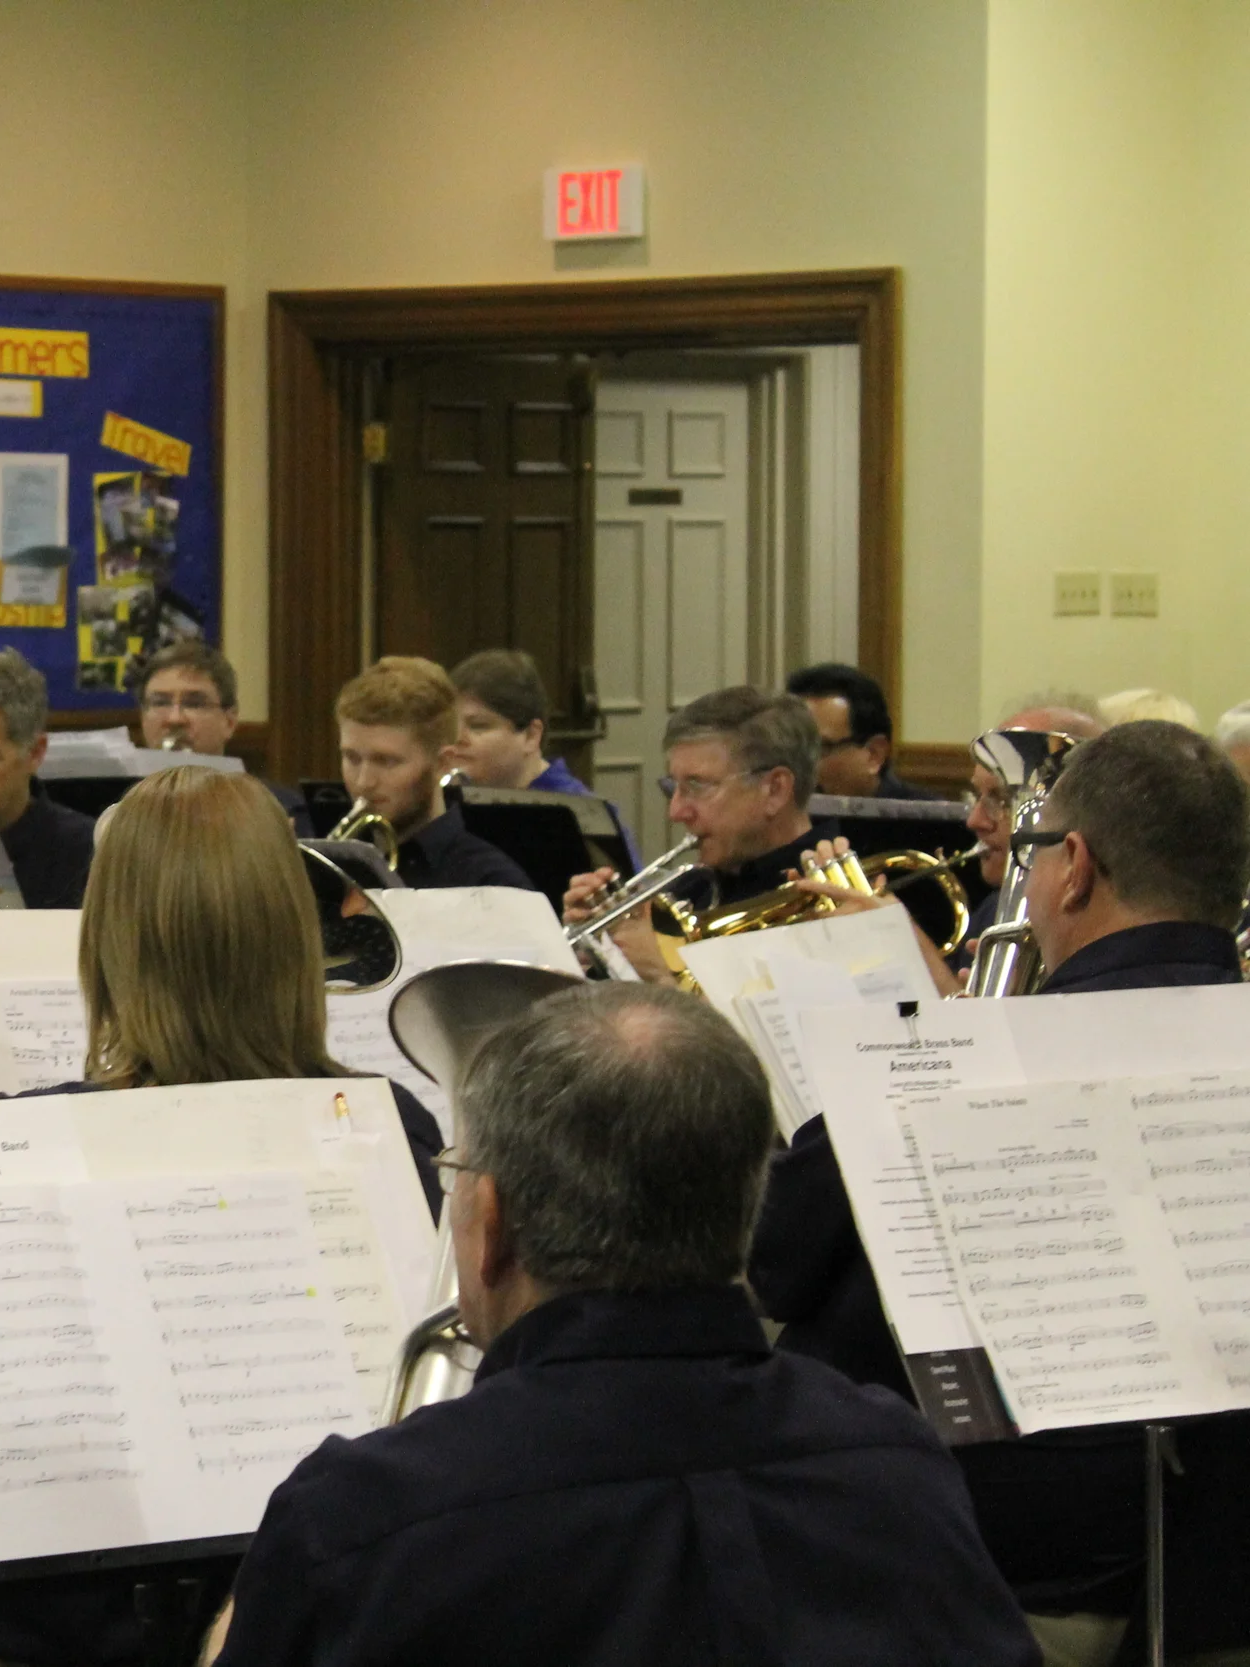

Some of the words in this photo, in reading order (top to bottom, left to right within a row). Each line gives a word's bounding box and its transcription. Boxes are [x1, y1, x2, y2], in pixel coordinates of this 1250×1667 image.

[557, 169, 622, 235] EXIT
[106, 410, 190, 475] Travel
[924, 1038, 949, 1049] Brass
[950, 1037, 974, 1047] Band
[890, 1059, 952, 1072] Americana
[0, 1140, 29, 1152] Band
